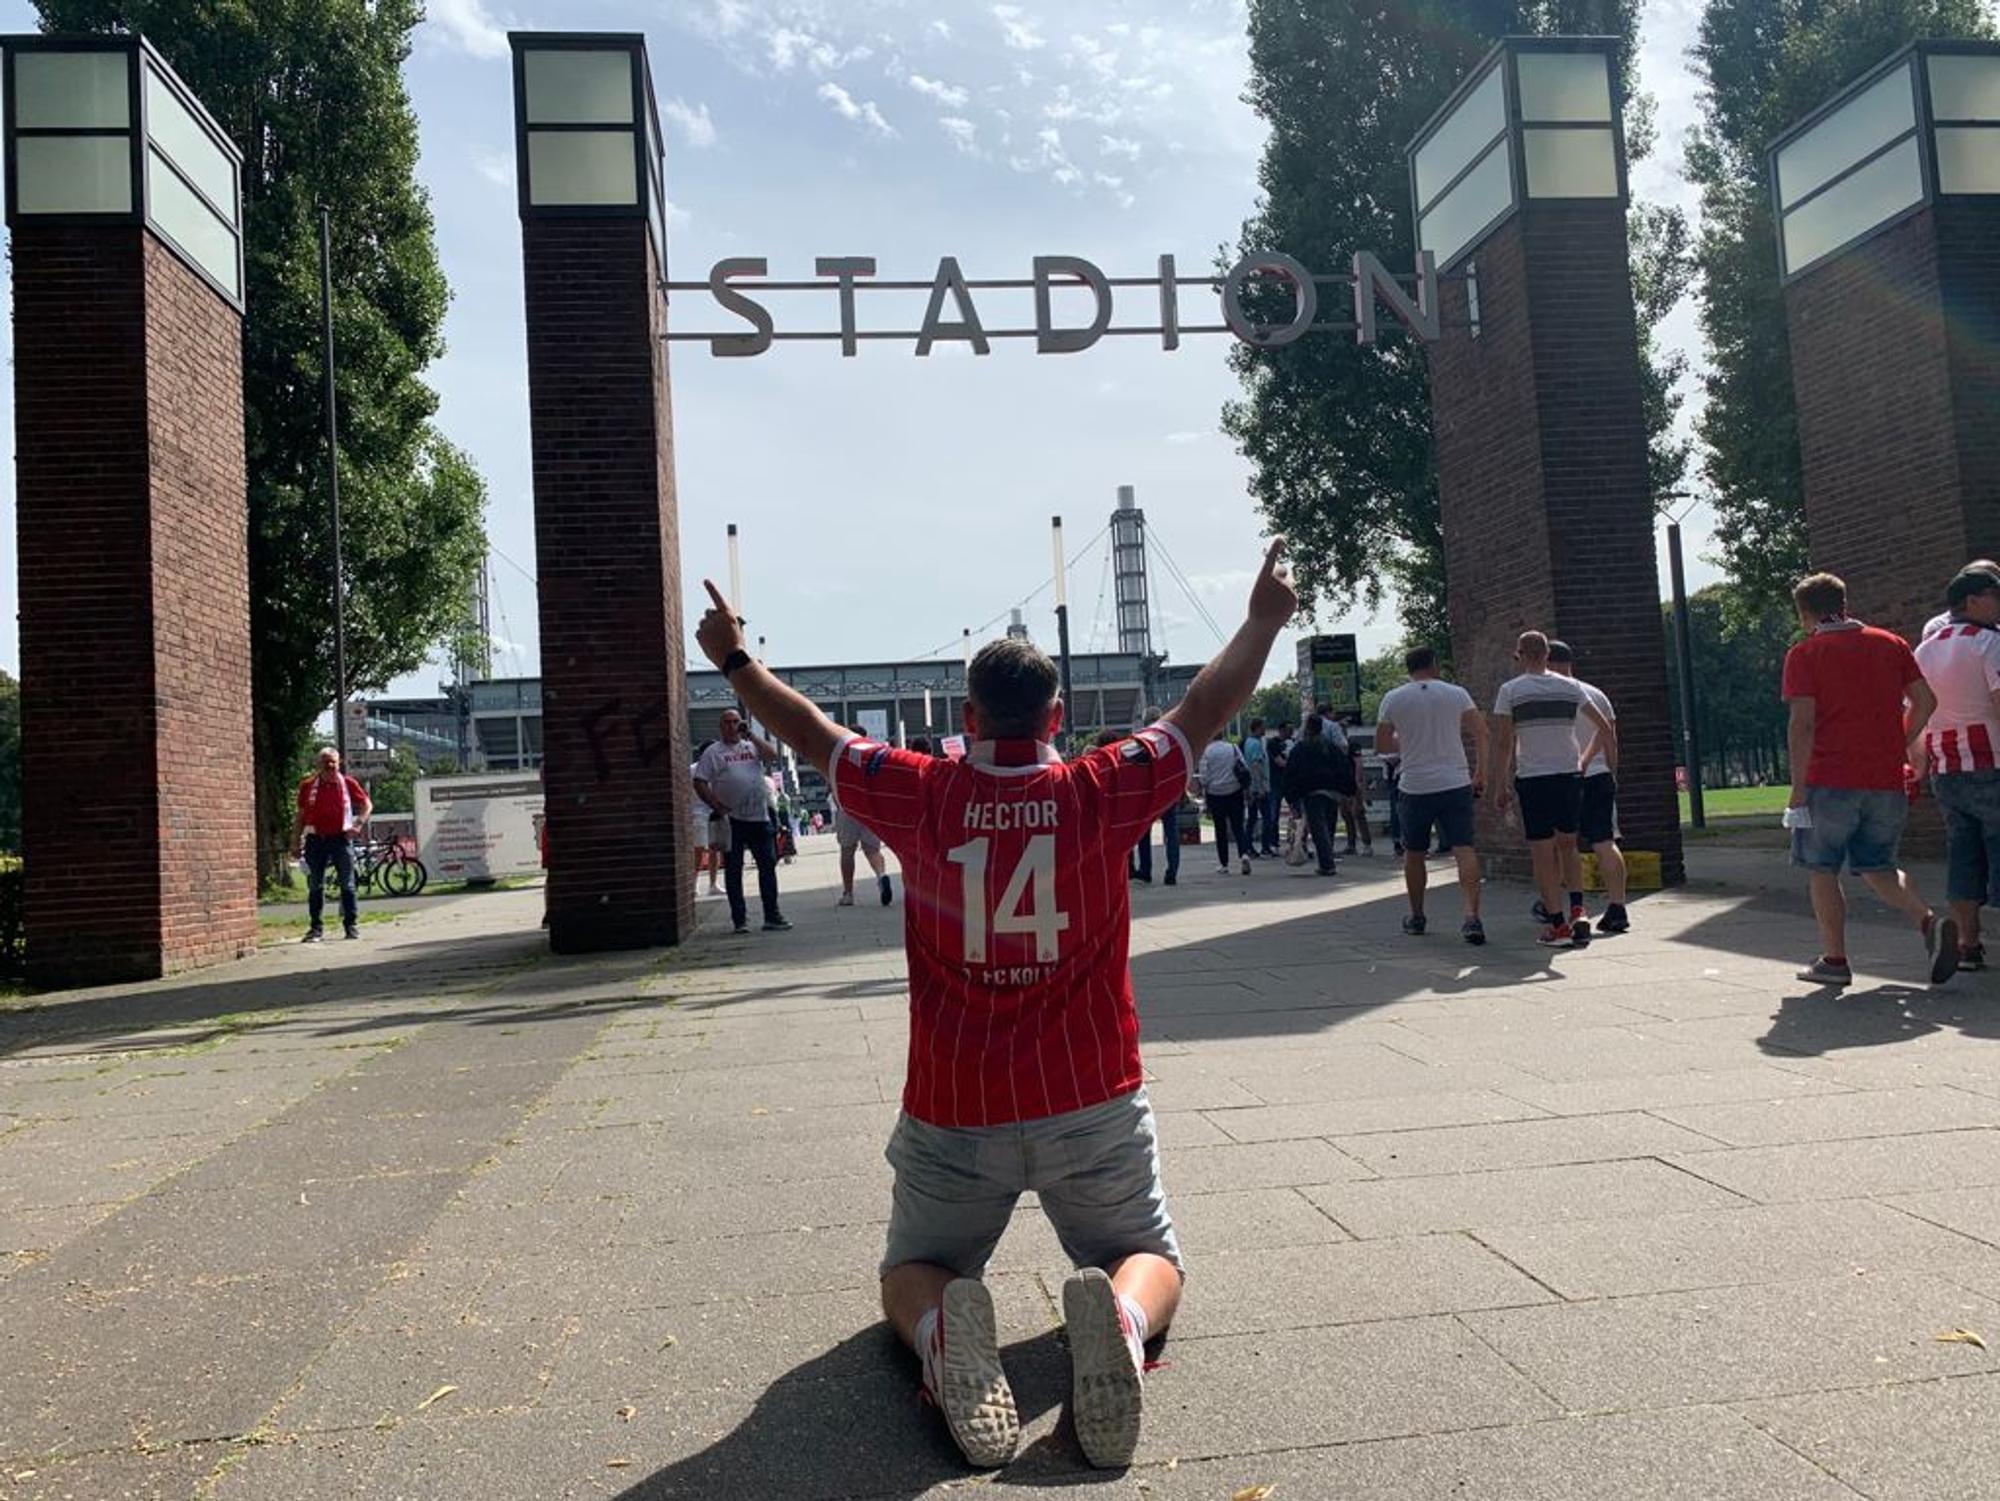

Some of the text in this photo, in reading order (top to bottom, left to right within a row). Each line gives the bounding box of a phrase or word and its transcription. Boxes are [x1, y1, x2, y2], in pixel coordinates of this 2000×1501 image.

[709, 250, 1441, 357] STADION
[963, 800, 1059, 830] HECTOR
[947, 834, 1069, 963] 14
